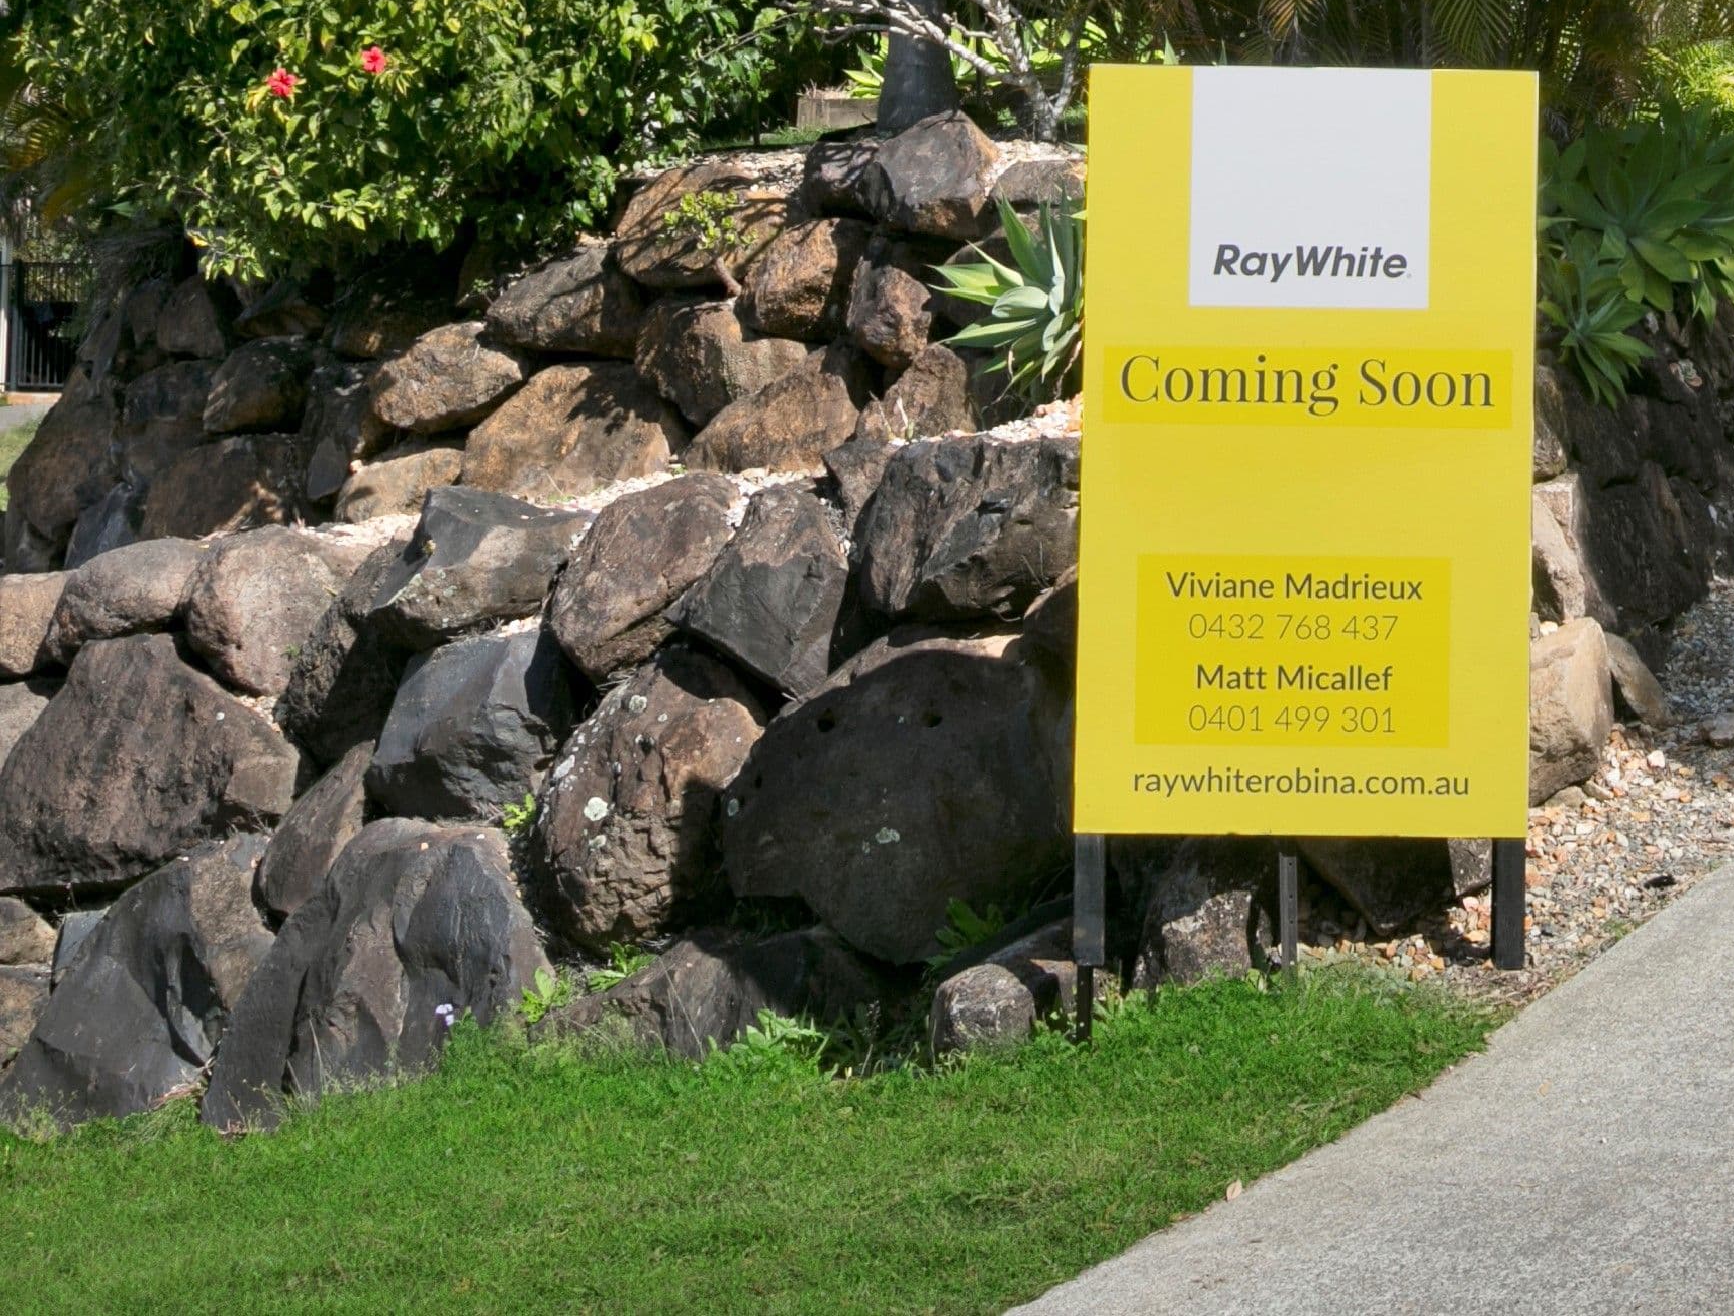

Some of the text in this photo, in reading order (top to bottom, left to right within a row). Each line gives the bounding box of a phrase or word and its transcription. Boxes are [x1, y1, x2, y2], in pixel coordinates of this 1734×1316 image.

[1121, 354, 1495, 417] Coming Soon
[1165, 571, 1423, 601] Viviane Madrieux
[1188, 613, 1399, 641] 0432 768 437
[1197, 664, 1393, 692] Matt Micallef
[1188, 704, 1396, 733] 0401 499 301
[1134, 765, 1470, 798] raywhiterobina.com.au
